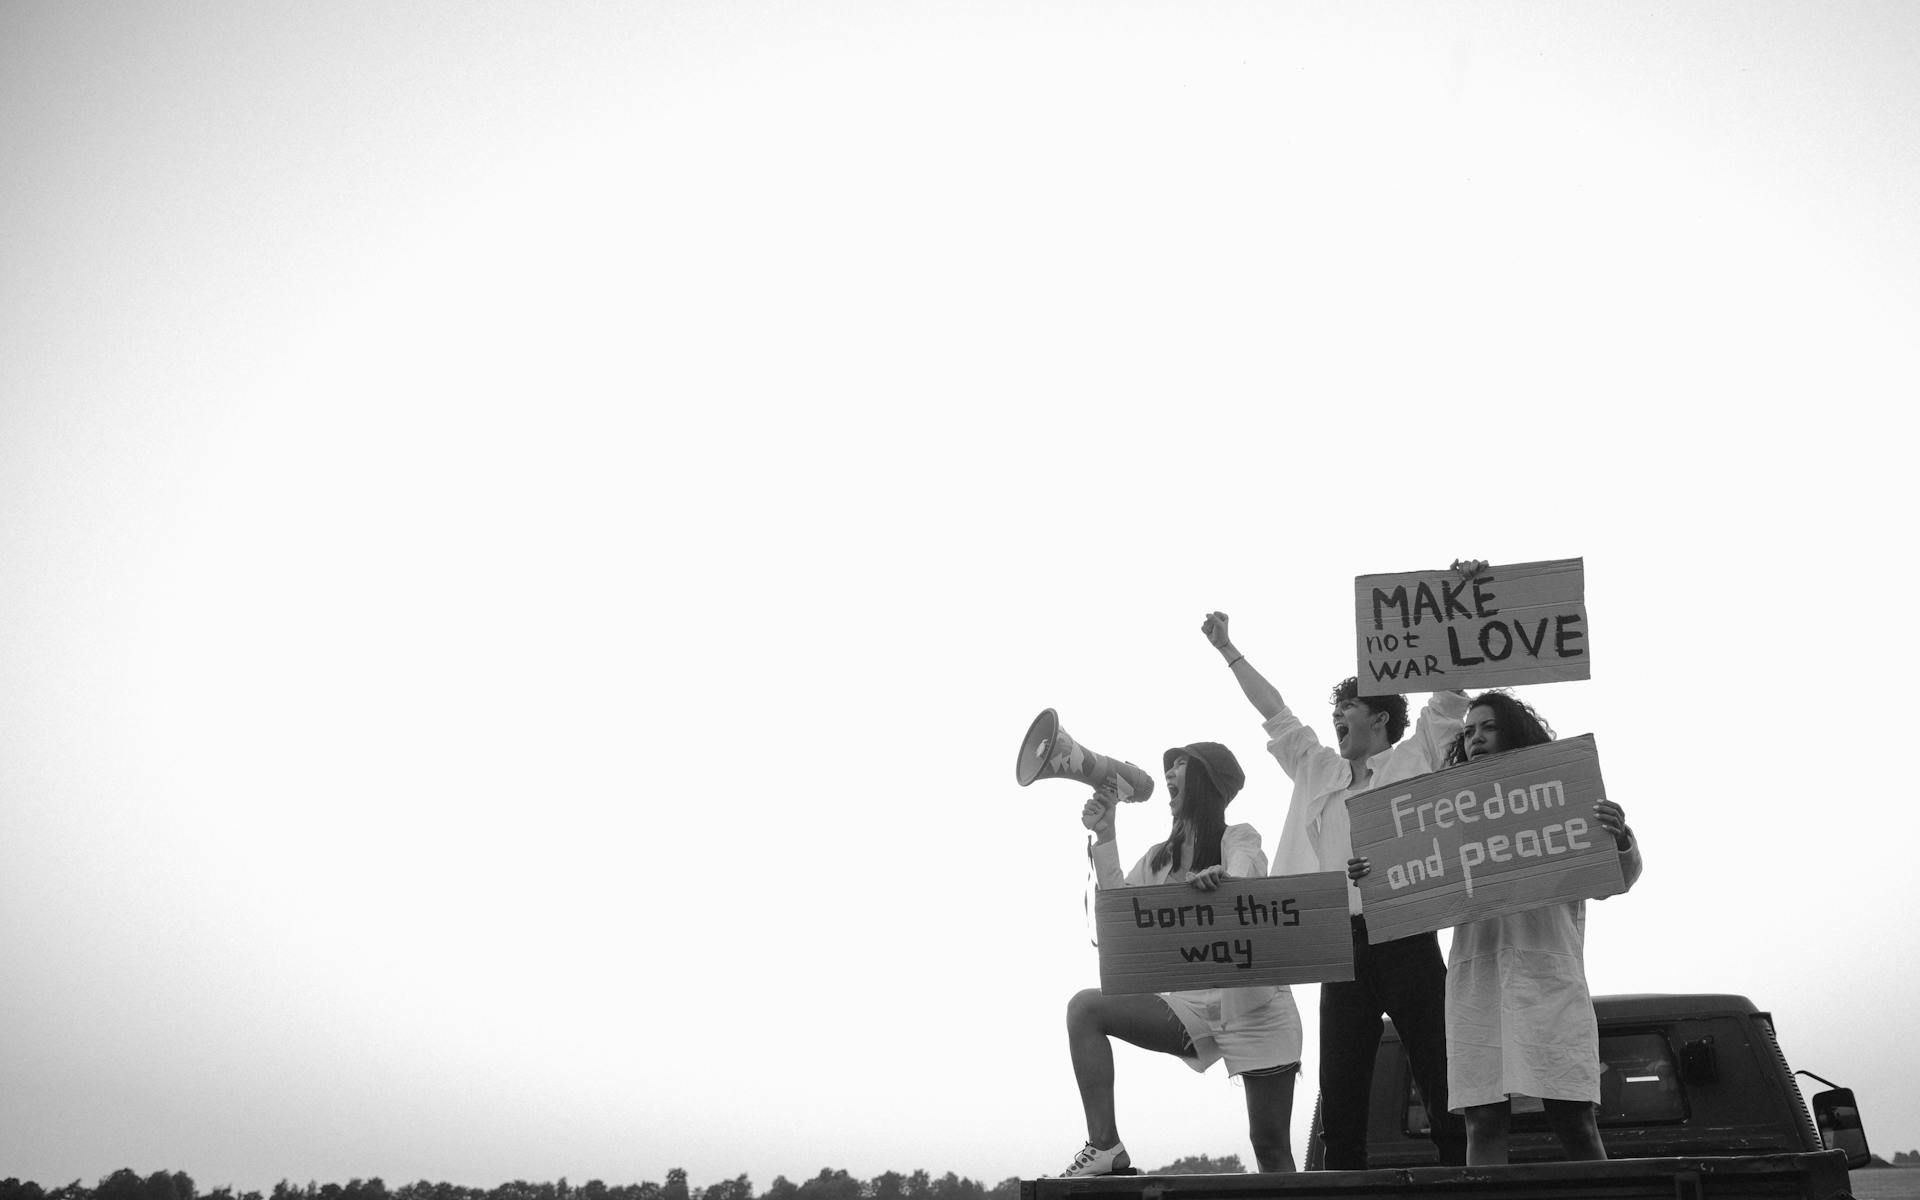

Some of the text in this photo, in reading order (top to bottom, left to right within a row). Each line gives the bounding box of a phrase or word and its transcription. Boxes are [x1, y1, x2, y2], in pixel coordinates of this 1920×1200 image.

[1372, 576, 1500, 630] MAKE
[1366, 632, 1420, 654] not
[1447, 614, 1584, 667] LOVE
[1368, 655, 1445, 682] WAR
[1390, 780, 1565, 838] Freedom
[1387, 818, 1591, 898] and peace
[1132, 894, 1300, 928] born this
[1180, 939, 1252, 969] way
